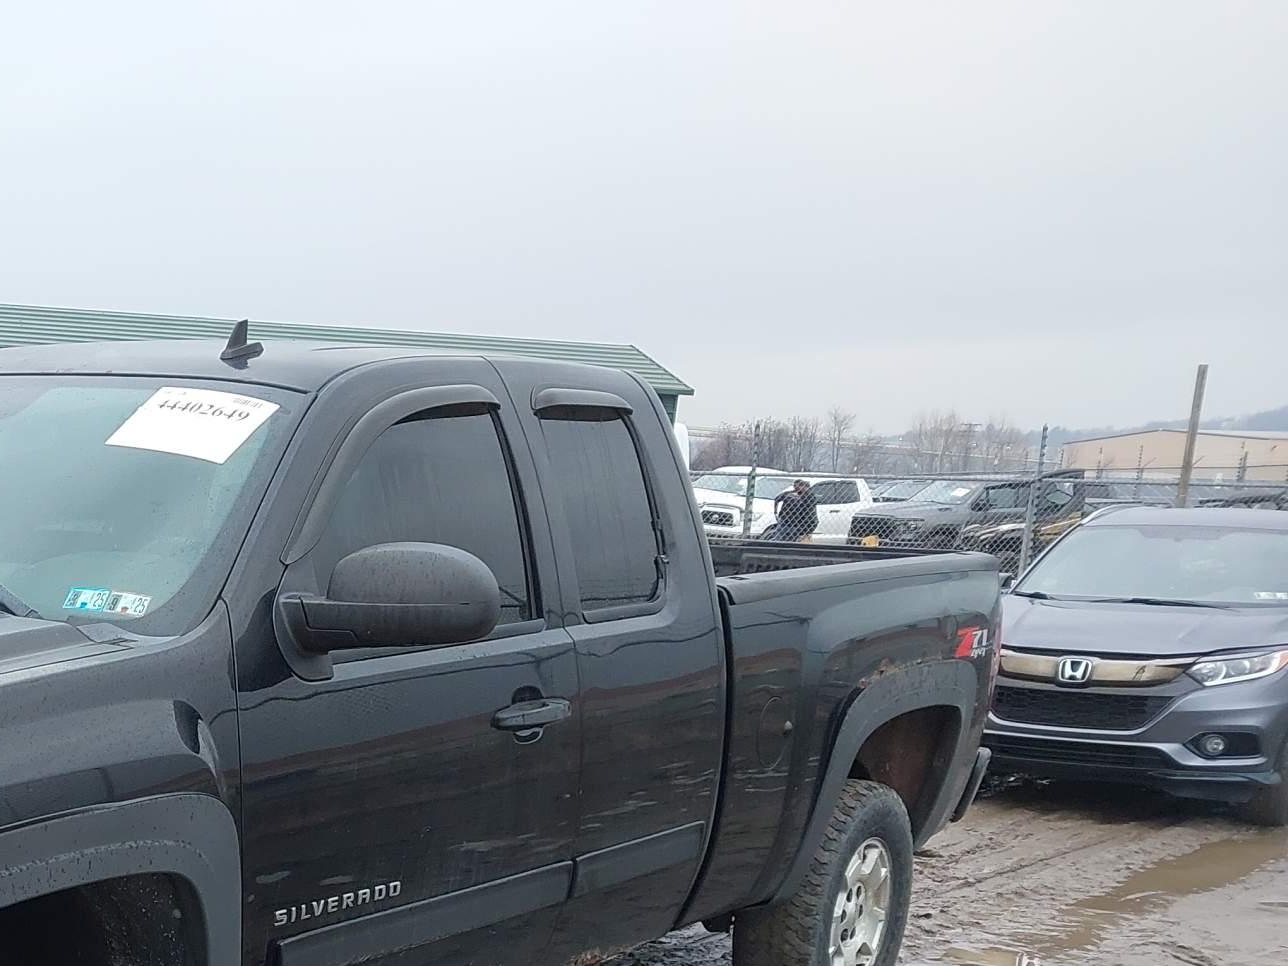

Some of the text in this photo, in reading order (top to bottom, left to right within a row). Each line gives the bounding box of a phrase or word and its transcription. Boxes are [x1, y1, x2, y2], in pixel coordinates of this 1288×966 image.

[159, 400, 250, 421] 44402649
[93, 592, 107, 608] 25
[133, 597, 148, 614] 25
[274, 881, 401, 926] SILVERADO
